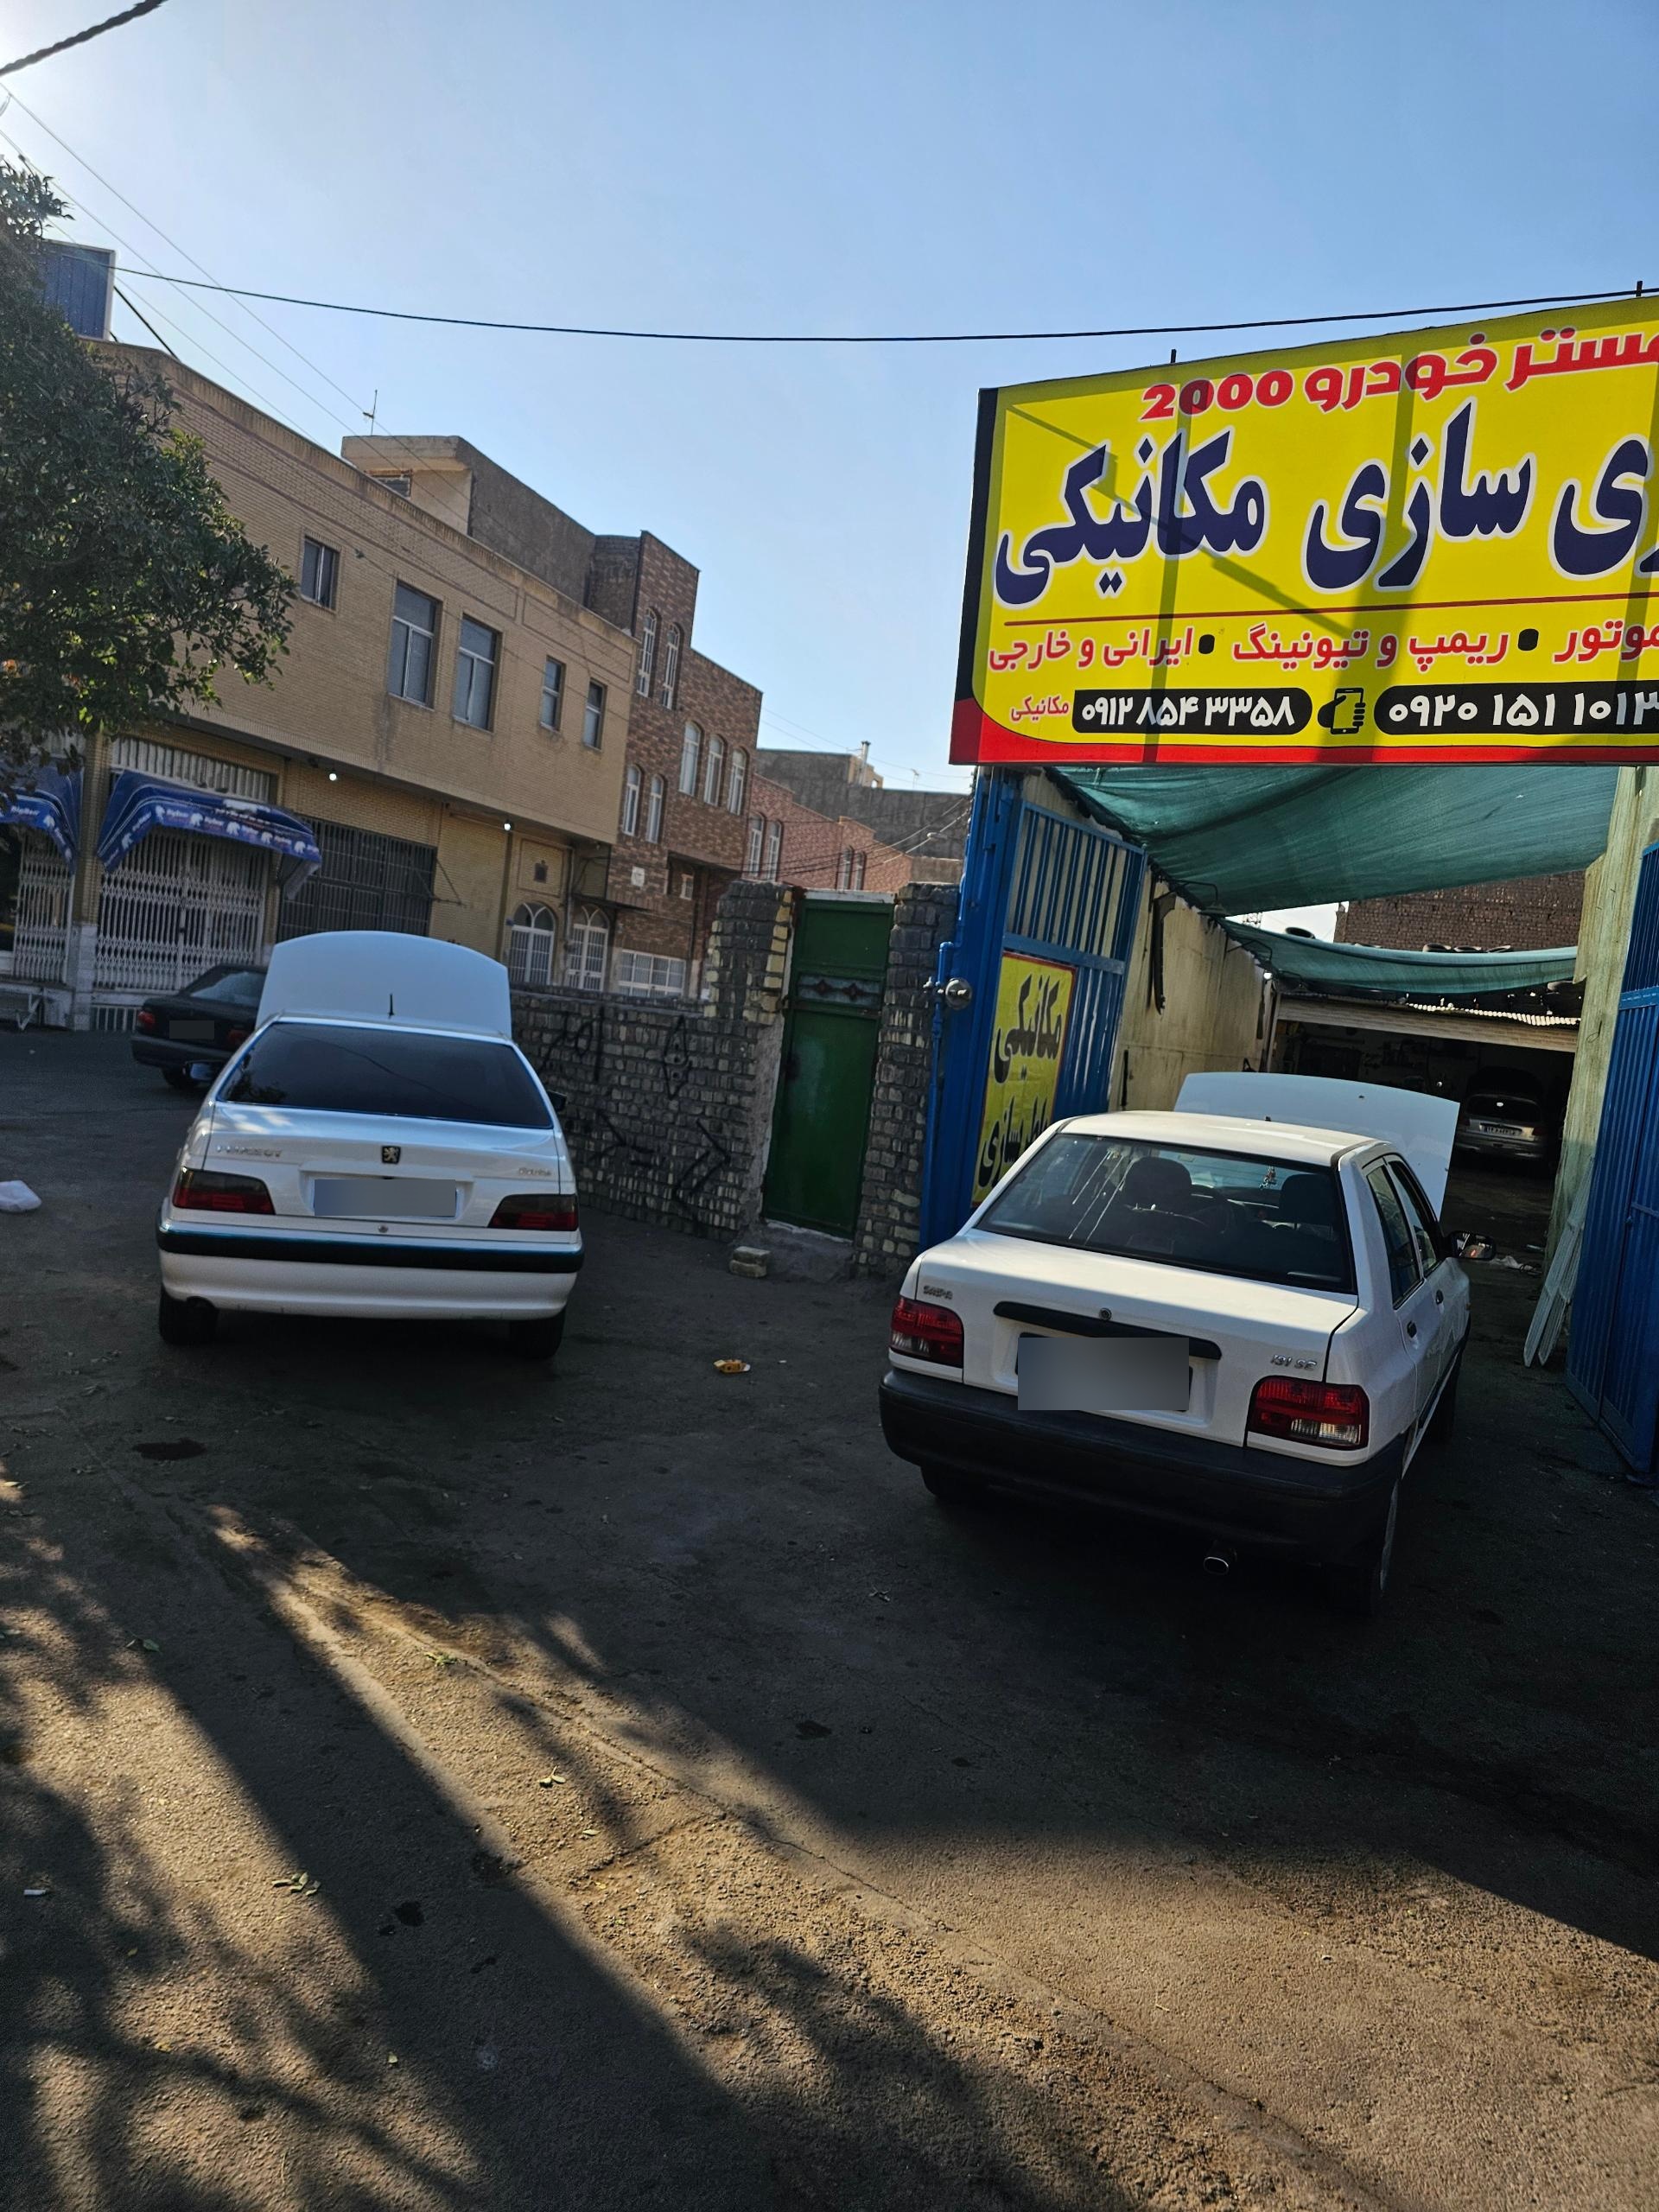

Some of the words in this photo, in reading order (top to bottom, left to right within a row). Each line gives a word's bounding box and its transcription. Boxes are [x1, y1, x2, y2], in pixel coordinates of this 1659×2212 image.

[1303, 331, 1498, 414] خودرو
[1140, 369, 1294, 421] 2000
[1306, 401, 1531, 589] سازی
[995, 429, 1267, 606] مکانیکی
[988, 630, 1071, 670] خارجی
[1077, 638, 1095, 668] و
[1103, 627, 1194, 666] ایرانی
[1233, 622, 1369, 669] تیونینگ
[1376, 634, 1398, 668] و
[1408, 632, 1509, 672] ریمپ
[1010, 695, 1070, 721] مکانیکی
[1081, 696, 1134, 726] ۰۹۱۲
[1135, 696, 1199, 727] ۸۵۴
[1205, 696, 1295, 727] ۳۳۵۸
[1388, 693, 1478, 727] ۰۹۲۰
[1492, 692, 1556, 727] ۱۵۱
[994, 973, 1062, 1084] مکانیکی
